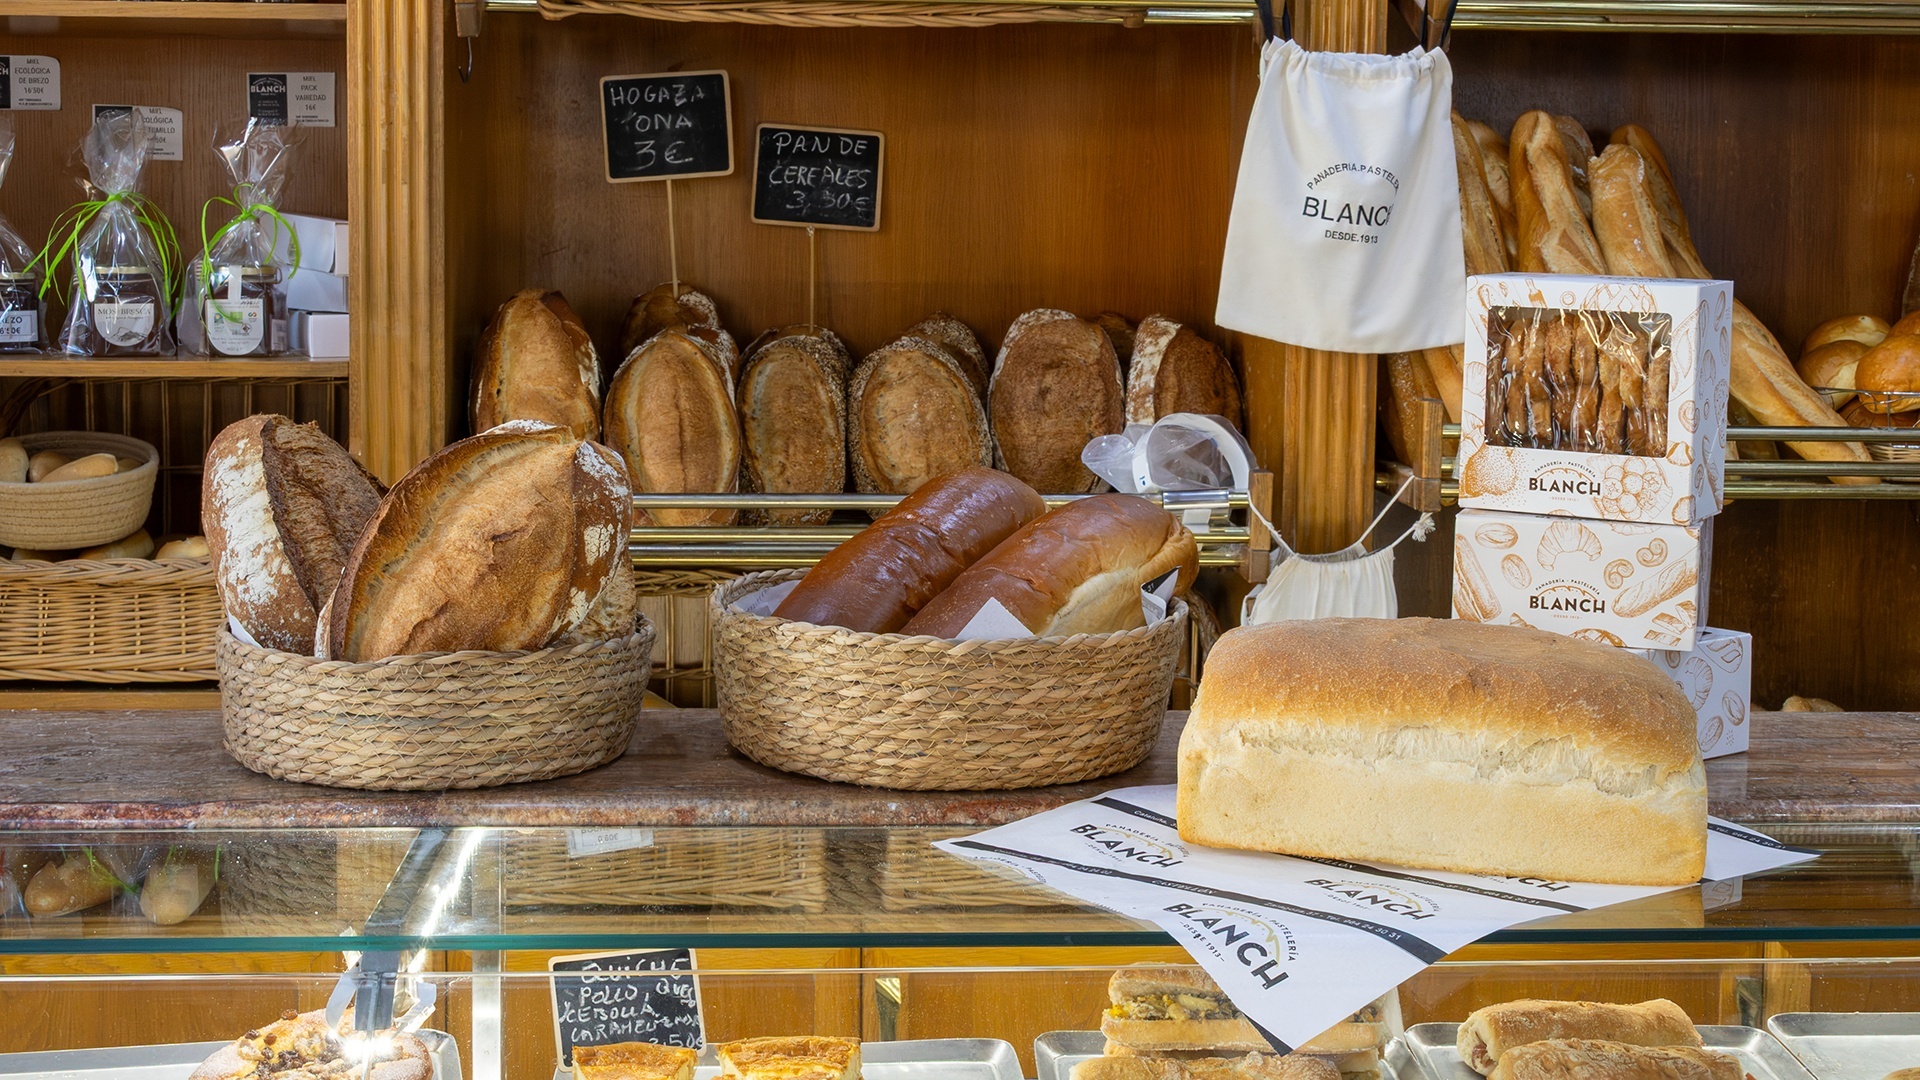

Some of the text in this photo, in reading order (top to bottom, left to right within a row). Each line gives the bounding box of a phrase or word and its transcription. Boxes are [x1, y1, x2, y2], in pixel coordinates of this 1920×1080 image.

[250, 85, 286, 93] BLANCH
[610, 84, 706, 107] HOGAZA
[773, 131, 868, 155] PAN DE
[1302, 196, 1393, 227] BLANC
[1529, 477, 1601, 496] BLANCH
[1529, 595, 1605, 614] BLANCH
[1070, 823, 1184, 868] BLANCH
[1303, 878, 1436, 921] BLANCH
[1363, 923, 1375, 931] 24
[1375, 926, 1388, 936] 30
[1389, 930, 1402, 941] 31
[1162, 902, 1290, 991] BLANCH
[1205, 942, 1222, 959] 1913
